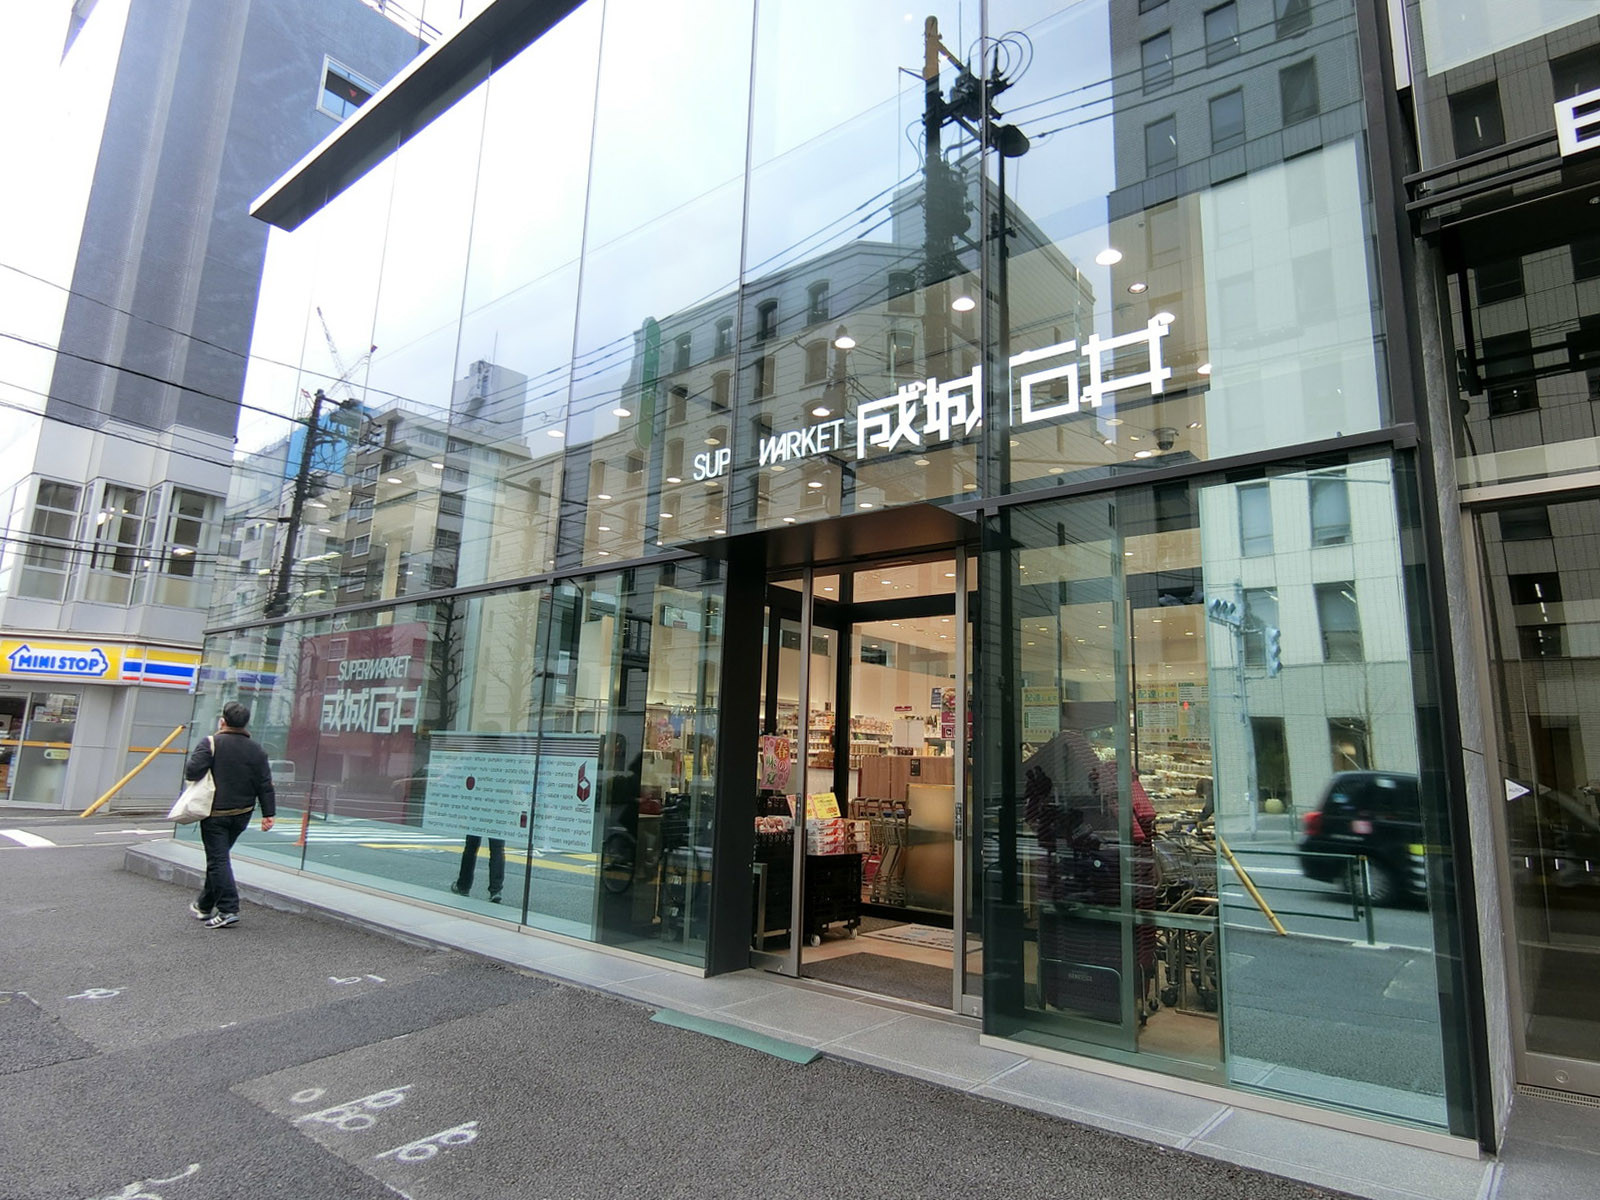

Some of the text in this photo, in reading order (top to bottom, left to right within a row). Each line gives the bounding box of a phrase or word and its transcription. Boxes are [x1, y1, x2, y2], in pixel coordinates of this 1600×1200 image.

[18, 655, 100, 671] MINI STOP
[338, 655, 412, 681] SUPERMARKET
[320, 686, 422, 733] 成城石井
